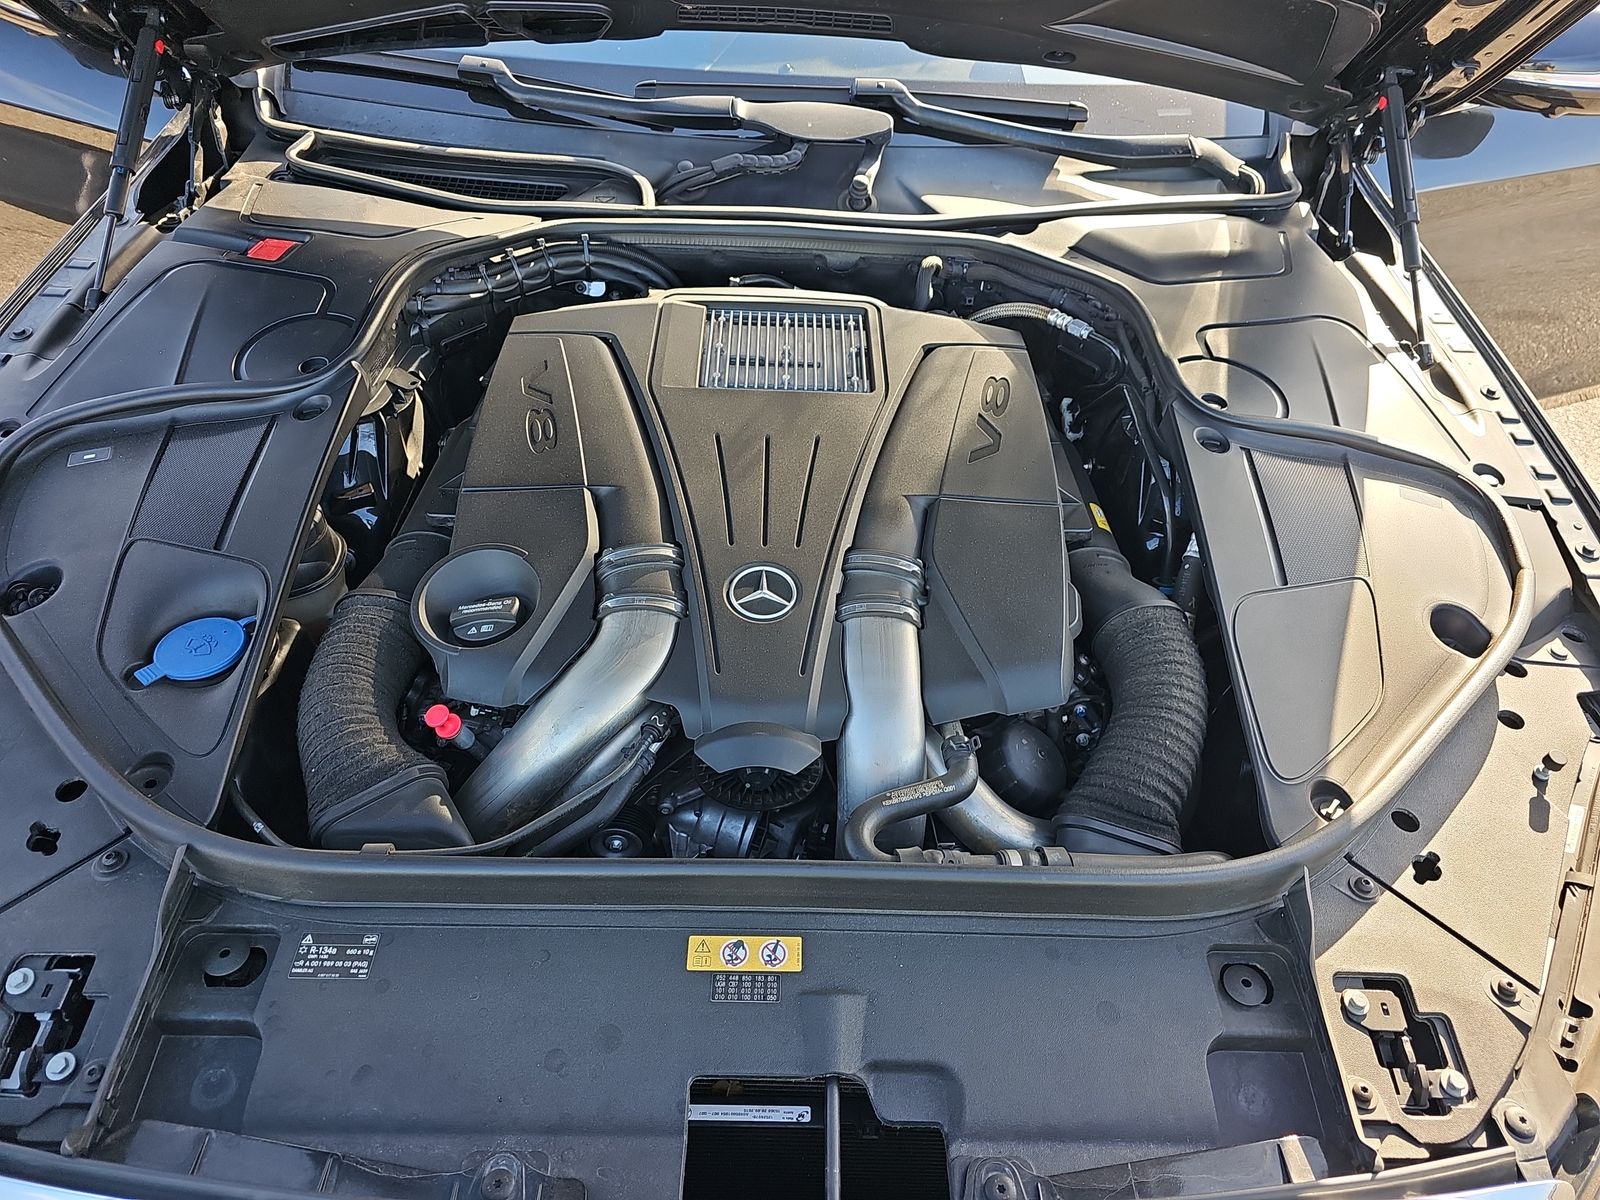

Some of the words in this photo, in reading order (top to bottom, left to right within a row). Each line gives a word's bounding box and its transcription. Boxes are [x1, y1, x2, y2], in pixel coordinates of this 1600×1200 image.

[521, 360, 557, 455] V8
[966, 376, 1011, 465] V8
[457, 600, 502, 611] Mercedes-Benz
[461, 605, 503, 614] recommended
[309, 946, 337, 955] R-134a
[352, 960, 369, 968] (PAG)
